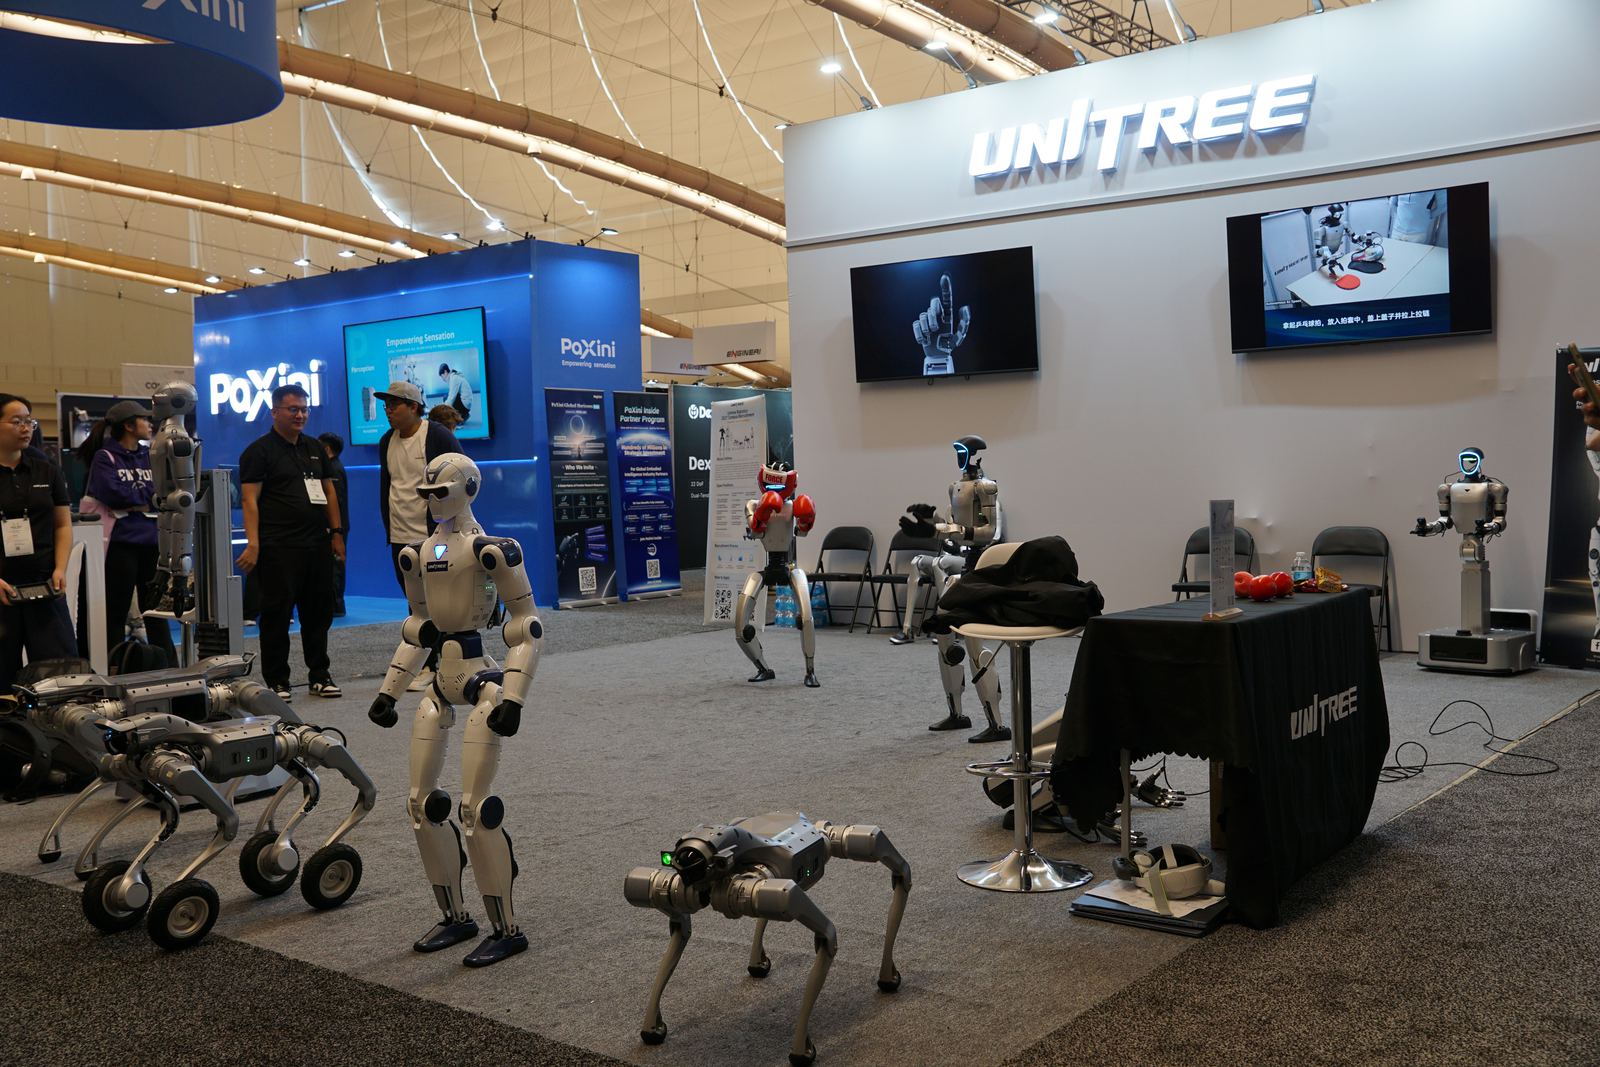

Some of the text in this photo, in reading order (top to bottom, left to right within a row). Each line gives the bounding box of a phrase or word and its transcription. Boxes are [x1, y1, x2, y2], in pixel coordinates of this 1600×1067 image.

[969, 73, 1317, 174] UNITREE
[386, 331, 455, 347] Empowering Sensation
[560, 337, 616, 359] PaXini
[209, 358, 320, 423] PaXini
[620, 415, 665, 425] Partner Program
[624, 406, 643, 414] PaXini
[1290, 685, 1358, 740] UNITREE
